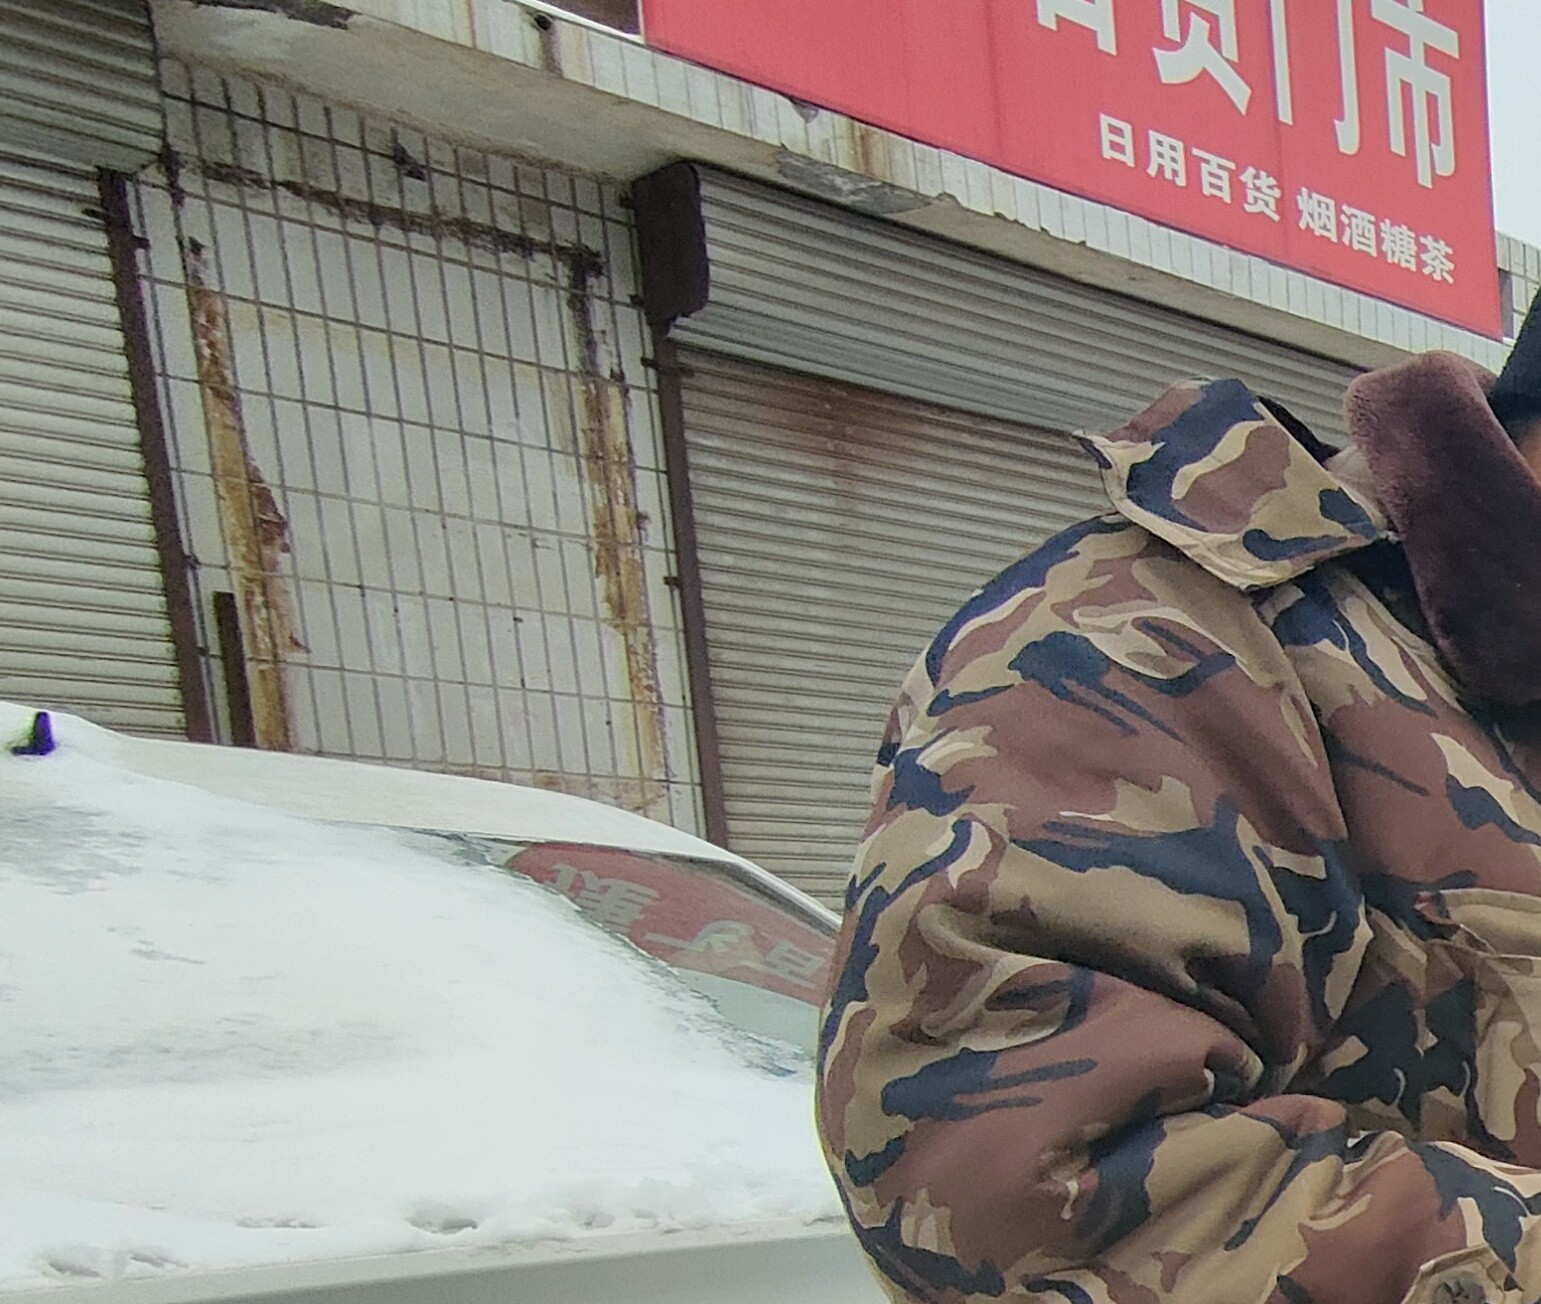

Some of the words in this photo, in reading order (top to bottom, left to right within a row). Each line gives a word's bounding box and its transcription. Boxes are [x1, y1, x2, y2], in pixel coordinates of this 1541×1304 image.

[1100, 113, 1281, 221] 日用百货
[1297, 187, 1456, 284] 烟酒糖茶
